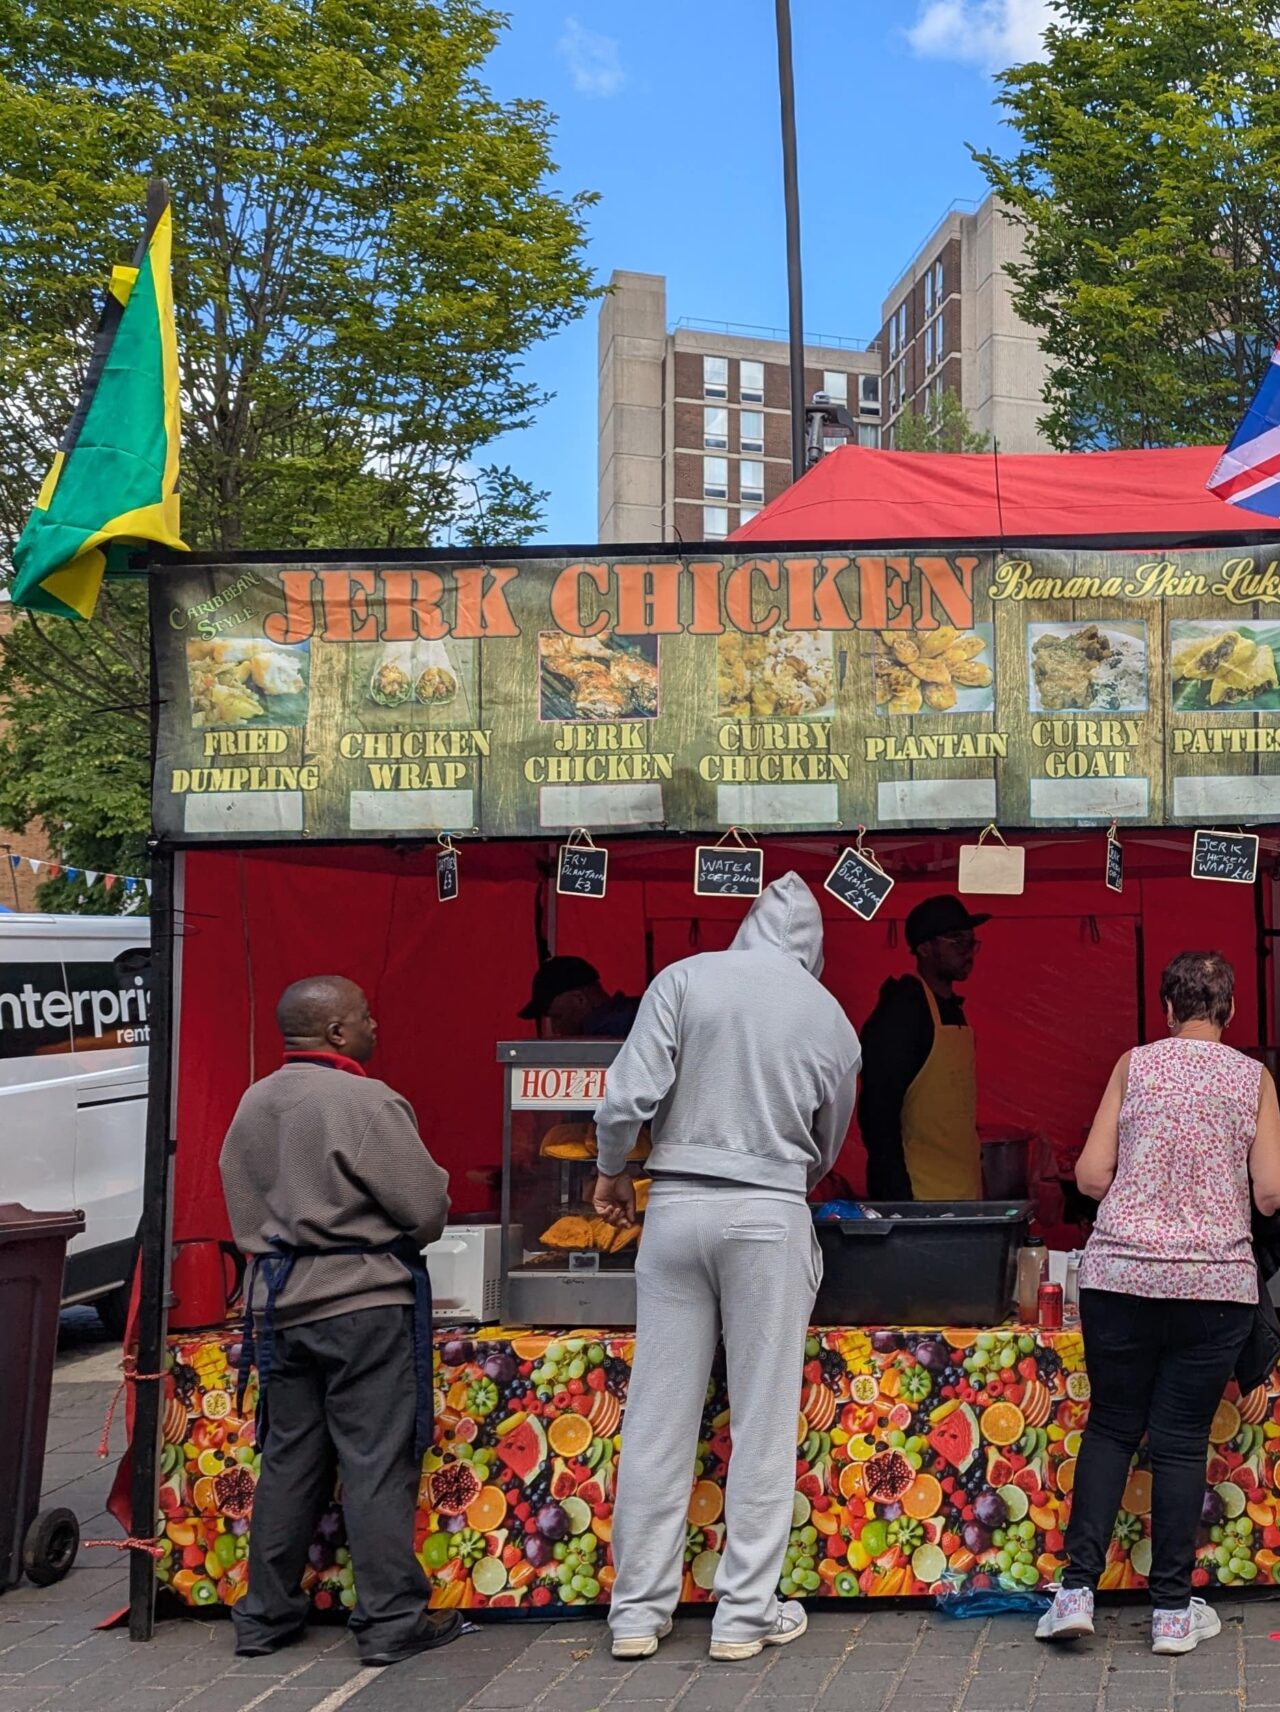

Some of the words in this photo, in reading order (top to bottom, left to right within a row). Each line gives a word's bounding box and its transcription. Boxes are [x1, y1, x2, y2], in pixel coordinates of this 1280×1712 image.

[988, 560, 1123, 600] Banana
[1125, 561, 1209, 598] Skin
[169, 571, 260, 630] CARIBBEAN
[263, 566, 522, 644] JERK
[551, 556, 981, 638] CHICKEN
[197, 606, 256, 641] STYLE
[202, 729, 289, 758] FRIED
[339, 729, 492, 760] CHICKEN
[555, 723, 645, 752] JERK
[717, 721, 832, 751] CURRY
[864, 731, 1009, 762] PLANTAIN
[1031, 719, 1145, 749] CURRY
[170, 764, 321, 794] DUMPLING
[367, 762, 467, 790] WRAP
[523, 753, 674, 784] CHICKEN
[698, 753, 851, 783] CHICKEN
[1044, 750, 1132, 779] GOAT
[563, 854, 588, 865] FRY
[1196, 838, 1243, 855] JERK
[700, 872, 732, 882] SOFT
[701, 858, 752, 872] WATER
[1199, 860, 1234, 874] WRAP
[1231, 866, 1255, 880] £10
[575, 877, 592, 892] £3
[719, 883, 739, 893] £2
[844, 890, 864, 909] £2
[520, 1069, 577, 1098] HOT
